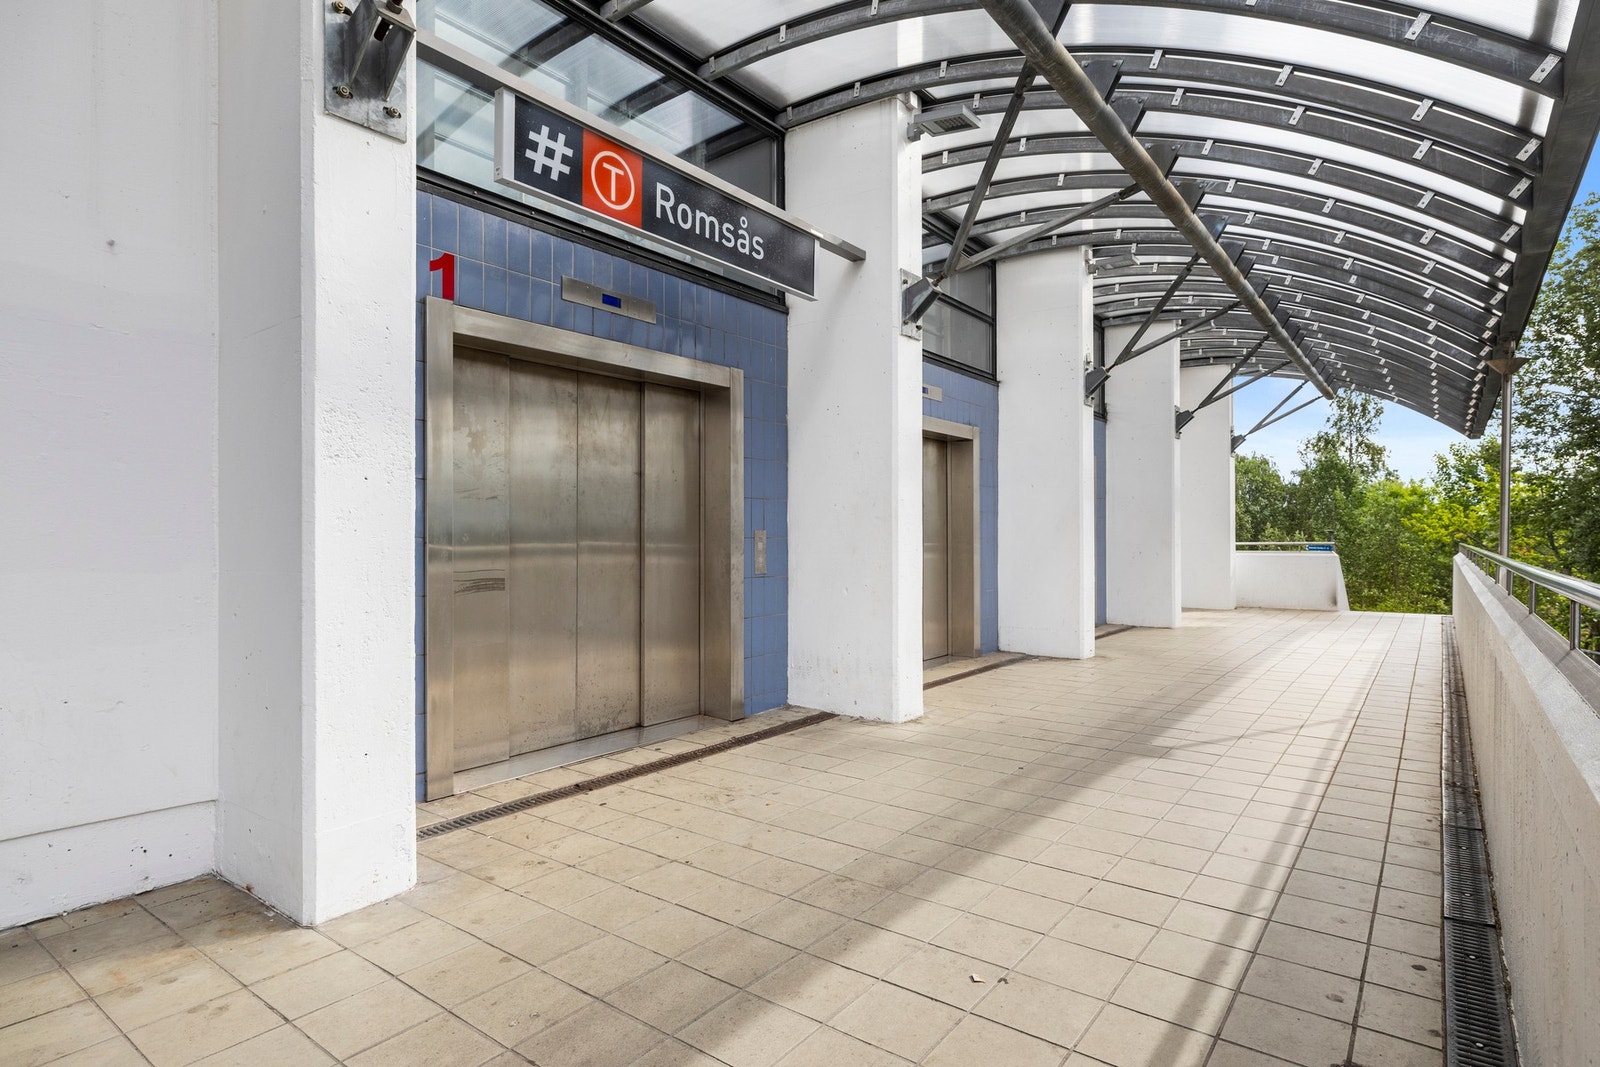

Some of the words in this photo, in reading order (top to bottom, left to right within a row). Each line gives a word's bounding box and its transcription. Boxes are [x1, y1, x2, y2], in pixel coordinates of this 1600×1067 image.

[602, 162, 624, 201] T
[656, 182, 764, 260] Romsås
[429, 252, 455, 301] 1
